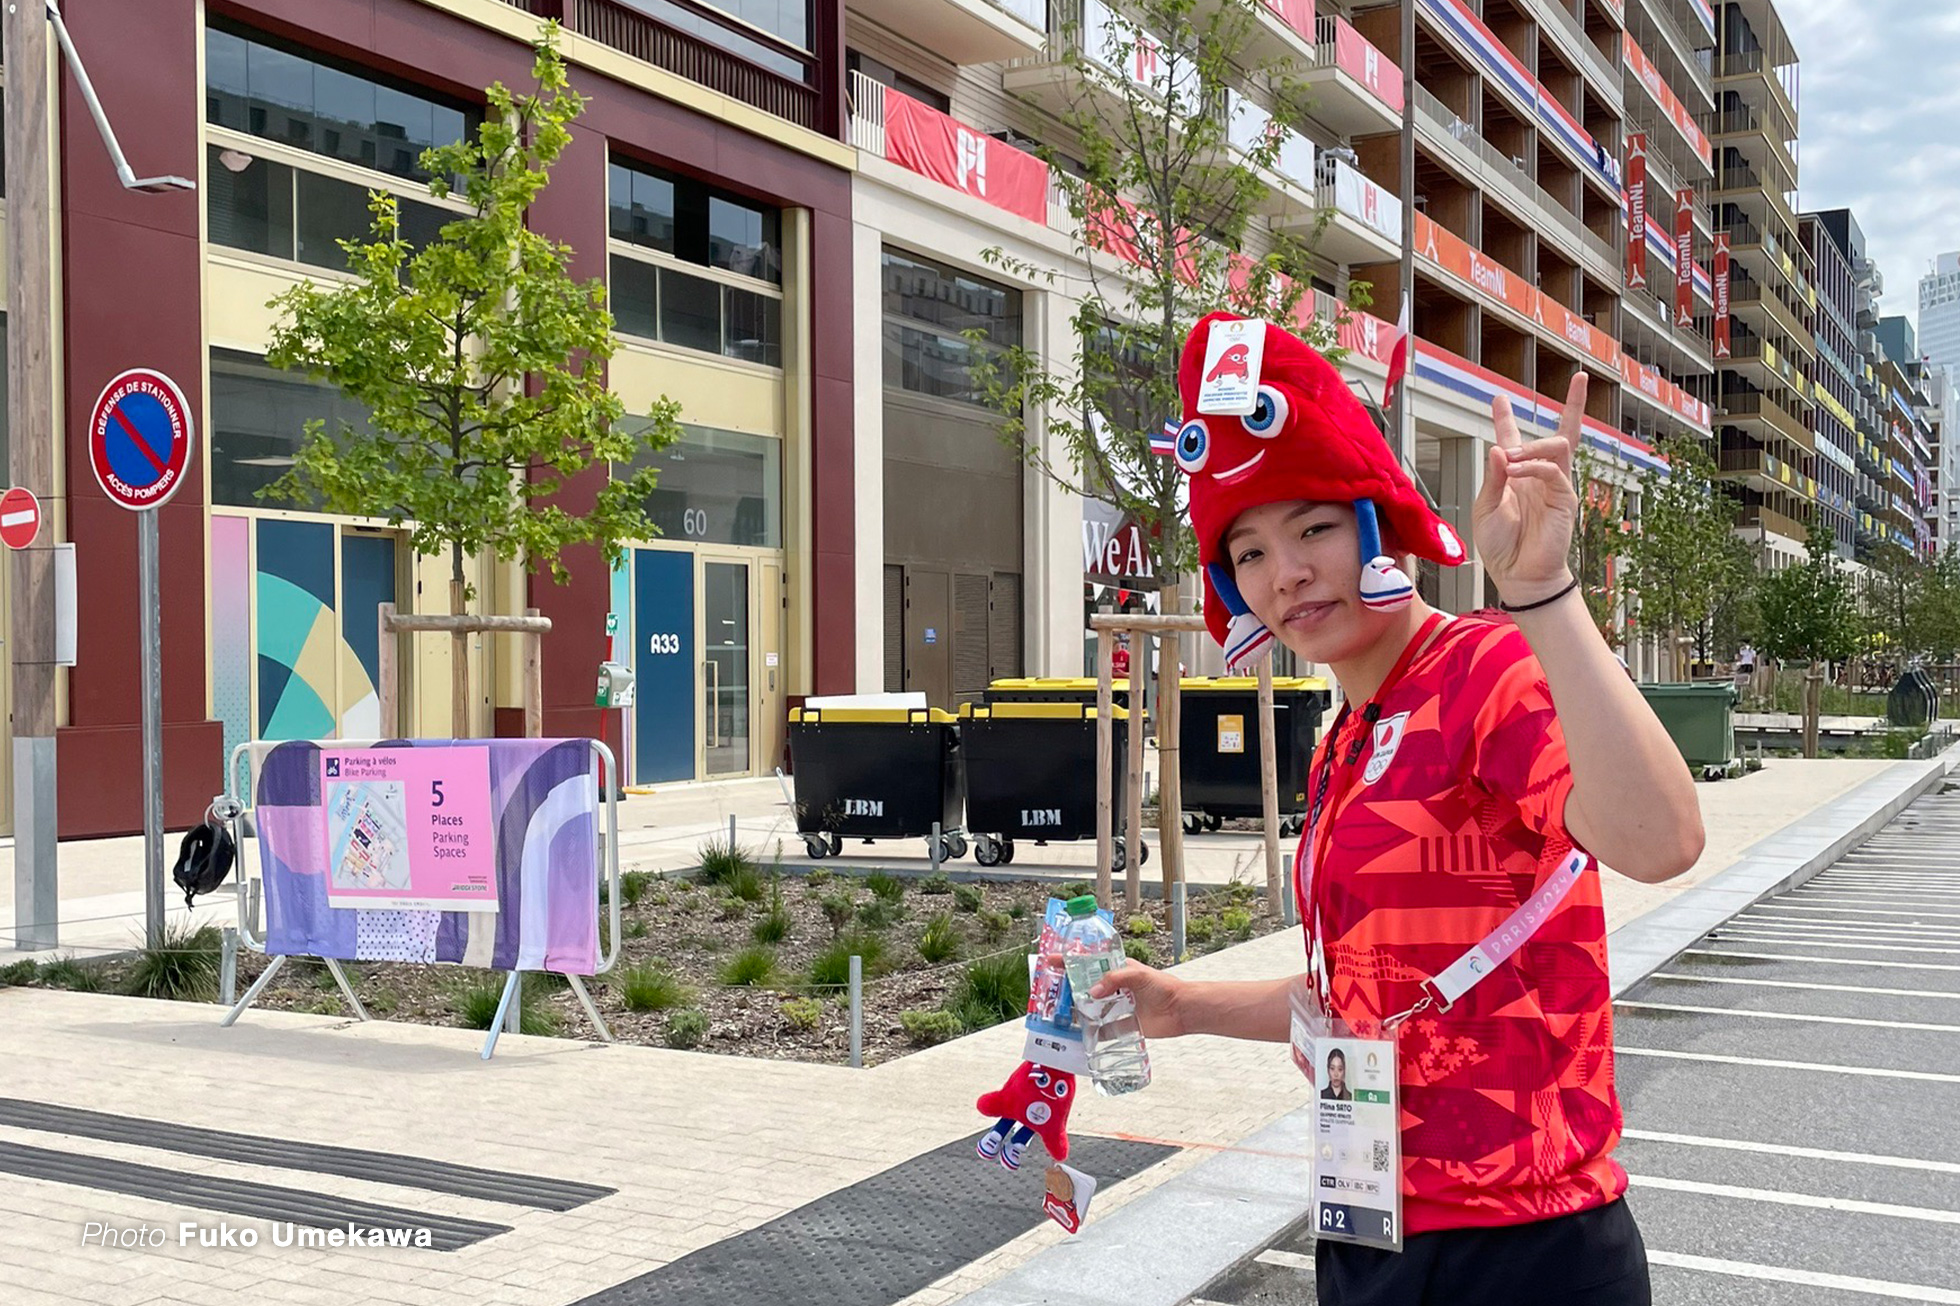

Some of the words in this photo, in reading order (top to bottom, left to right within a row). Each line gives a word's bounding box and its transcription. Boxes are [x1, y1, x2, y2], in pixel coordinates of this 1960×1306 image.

[1629, 180, 1644, 243] TeamNL
[1678, 230, 1692, 286] TeamNL
[1469, 250, 1508, 300] TeamNL
[1715, 270, 1728, 321] TeamNL
[1564, 312, 1592, 350] TeamNL
[97, 387, 126, 436] DÉFENSE
[126, 381, 139, 393] DE
[141, 381, 181, 440] STATIONNER
[106, 472, 133, 499] ACCÈS
[134, 468, 175, 499] POMPIERS
[683, 508, 707, 536] 60
[1082, 519, 1121, 576] We
[650, 633, 680, 655] A33
[344, 757, 371, 768] Parking
[344, 768, 360, 777] Bike
[361, 768, 387, 779] Parking
[431, 780, 445, 807] 5
[431, 814, 464, 827] Places
[845, 799, 884, 818] LBM
[1021, 809, 1062, 826] LBM
[432, 831, 470, 846] Parking
[433, 846, 467, 860] Spaces
[1491, 912, 1535, 955] PARIS
[1534, 875, 1568, 913] 2024
[1383, 1216, 1392, 1236] R
